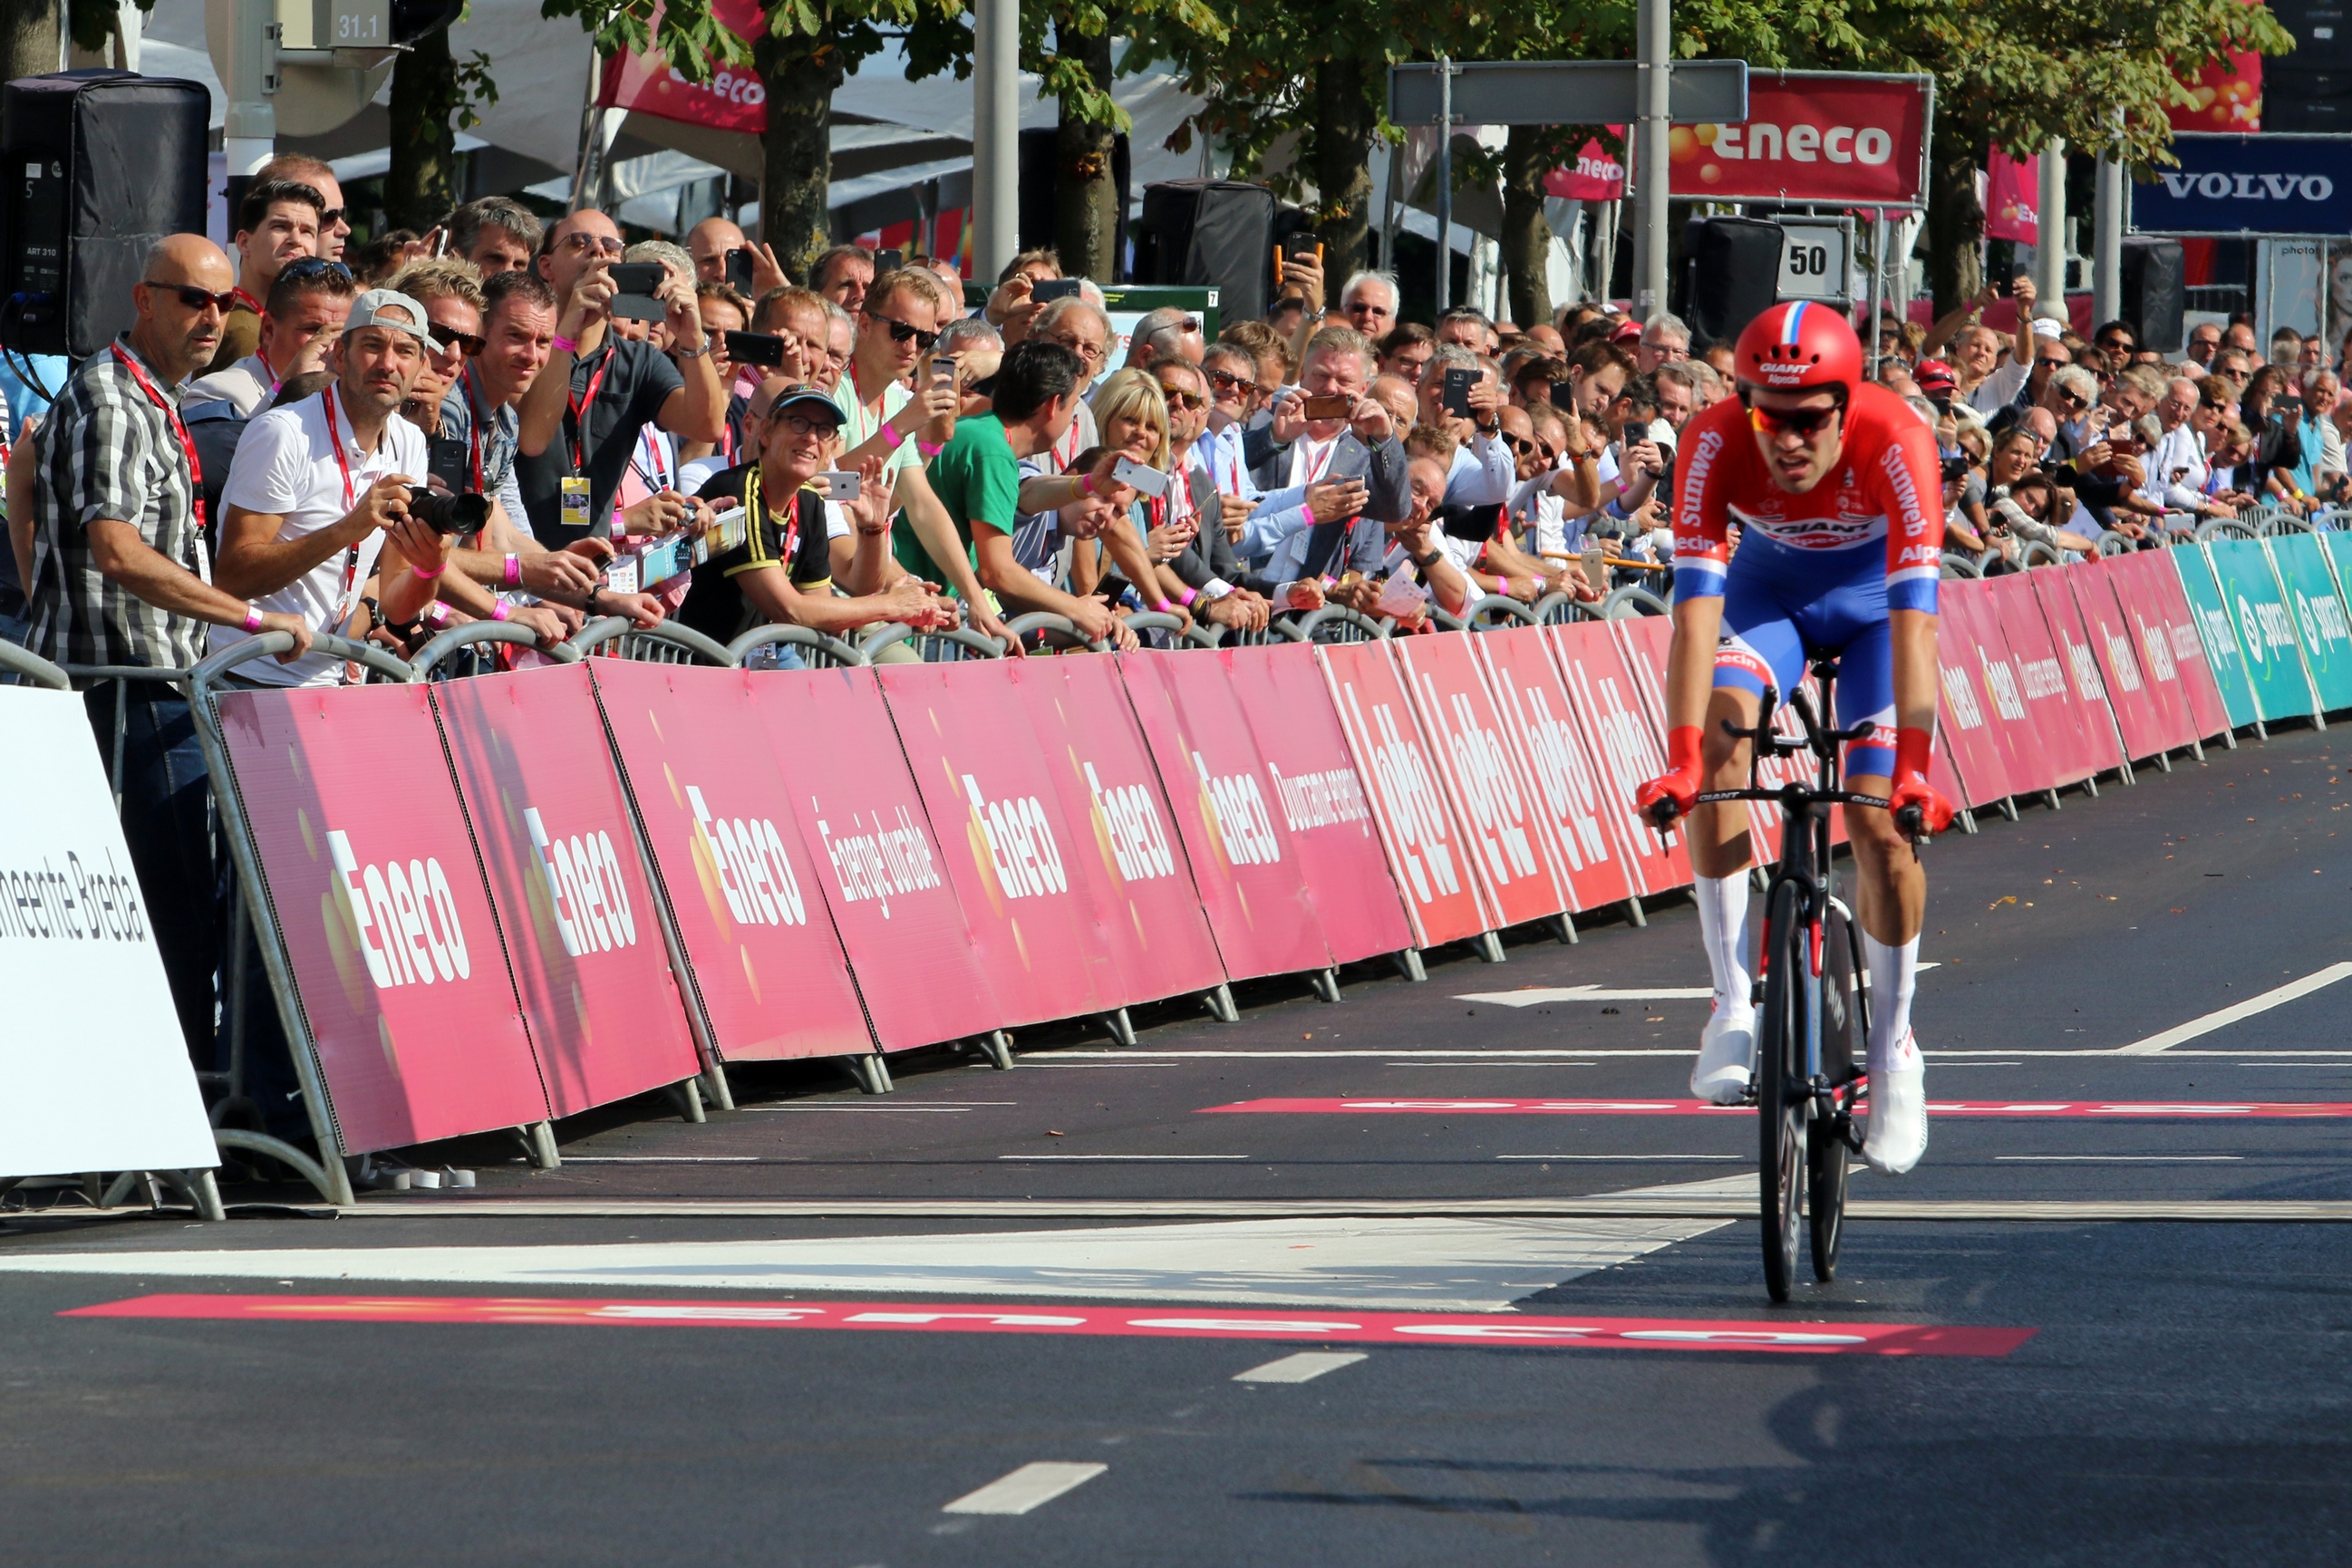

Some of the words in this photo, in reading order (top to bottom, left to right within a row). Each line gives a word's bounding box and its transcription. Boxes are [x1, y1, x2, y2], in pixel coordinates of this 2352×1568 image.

[339, 14, 377, 38] 31.1
[669, 67, 766, 105] eco
[1710, 123, 1892, 165] Eneco
[2160, 171, 2334, 201] VOLVO
[26, 247, 41, 256] ART
[42, 247, 57, 256] 310
[1789, 245, 1827, 276] 50
[1209, 294, 1216, 305] 7
[1759, 363, 1812, 375] GIANT
[1767, 373, 1801, 385] Alpecin
[1680, 426, 1726, 528] Sunweb
[1880, 443, 1928, 538] Sunweb
[1774, 521, 1875, 534] GIANT
[1191, 750, 1281, 866] Eneco
[1699, 791, 1740, 802] GIANT
[962, 774, 1068, 899] Eneco
[1083, 760, 1176, 883] Eneco
[685, 785, 807, 927] Eneco
[811, 795, 894, 920] Énergie
[871, 804, 941, 895] durable
[0, 856, 83, 941] meente
[66, 846, 146, 943] Breda
[524, 807, 637, 958] Eneco
[326, 829, 471, 989] Eneco
